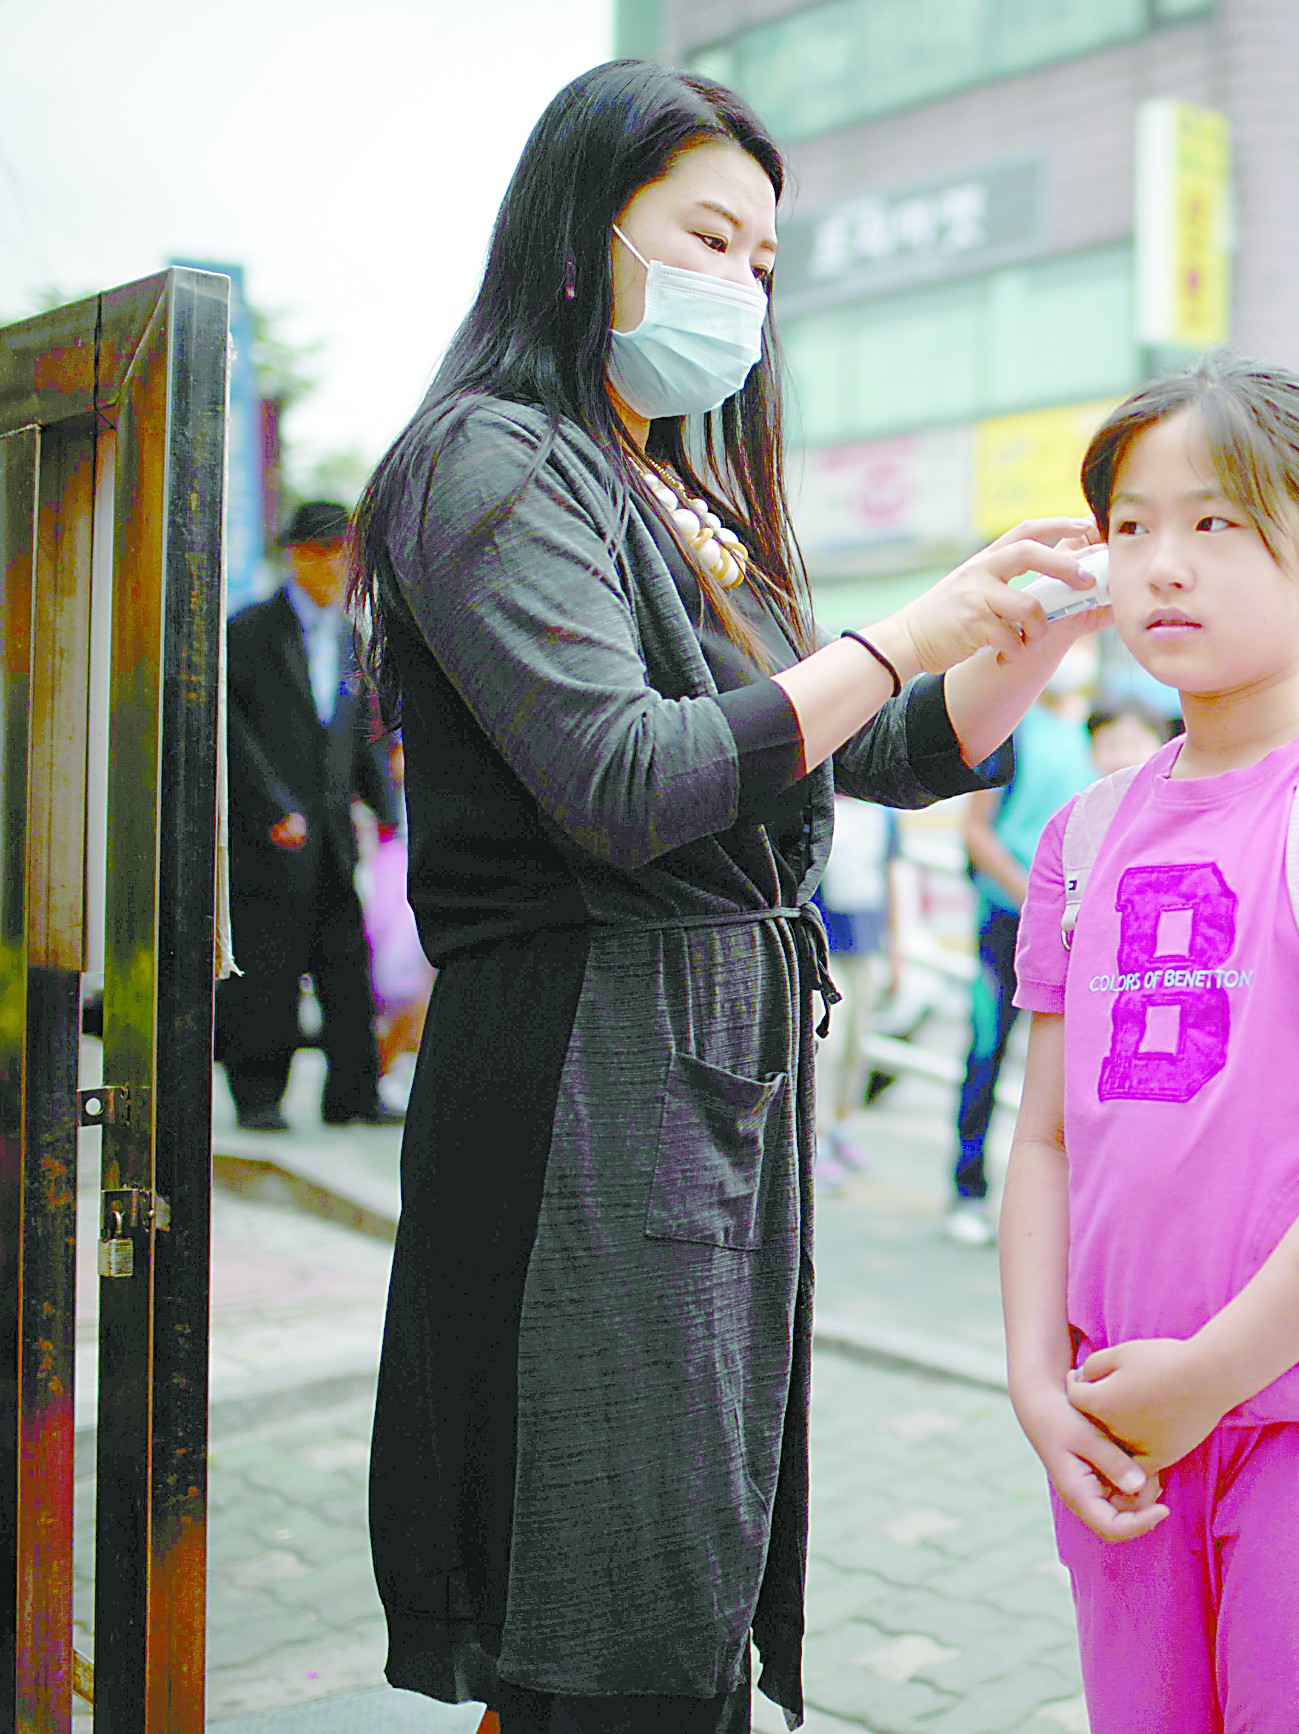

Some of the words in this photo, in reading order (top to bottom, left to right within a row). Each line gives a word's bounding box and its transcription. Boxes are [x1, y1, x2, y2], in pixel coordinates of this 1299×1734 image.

[1089, 972, 1141, 993] COLORS
[1143, 970, 1163, 990] OF
[1163, 968, 1254, 990] BENETTON
